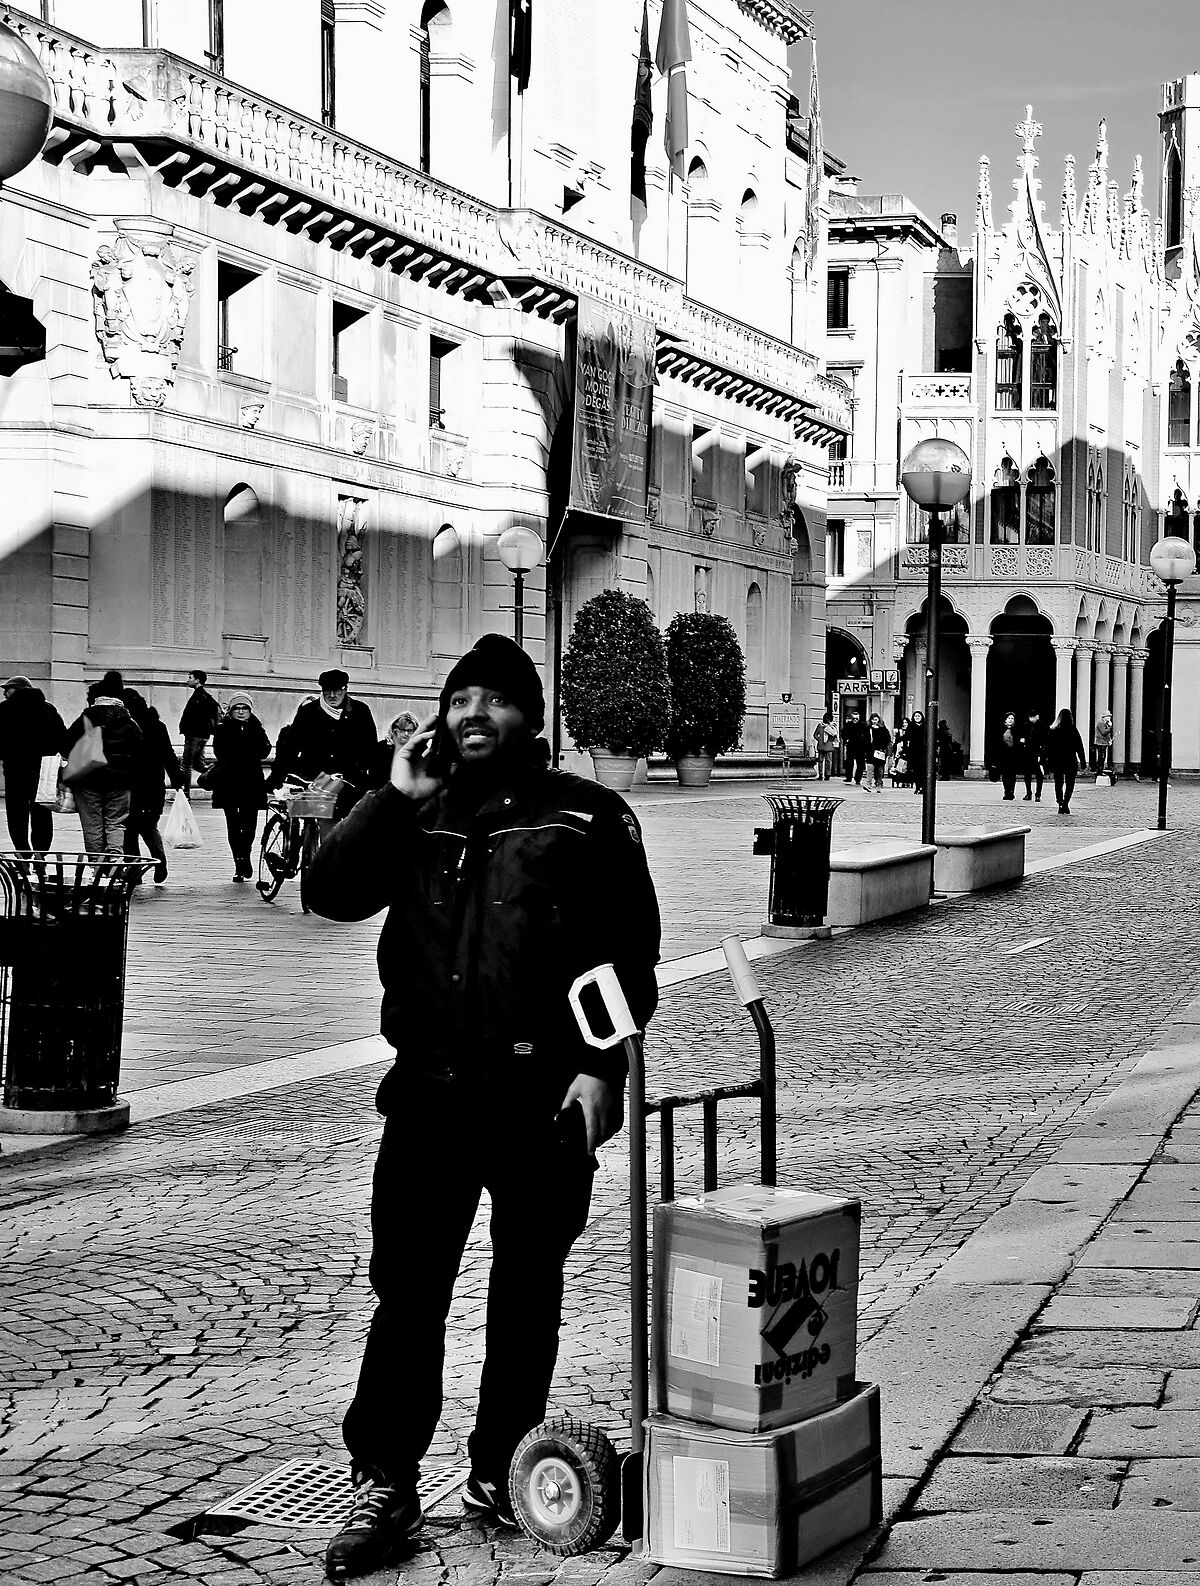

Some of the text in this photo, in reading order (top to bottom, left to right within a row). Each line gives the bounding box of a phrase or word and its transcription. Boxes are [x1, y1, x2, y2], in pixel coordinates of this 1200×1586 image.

[579, 362, 614, 384] VAN GOG
[585, 379, 611, 397] MONET
[585, 394, 611, 412] DEGAS
[747, 1247, 840, 1308] JOVENE
[754, 1343, 831, 1386] edizioni
